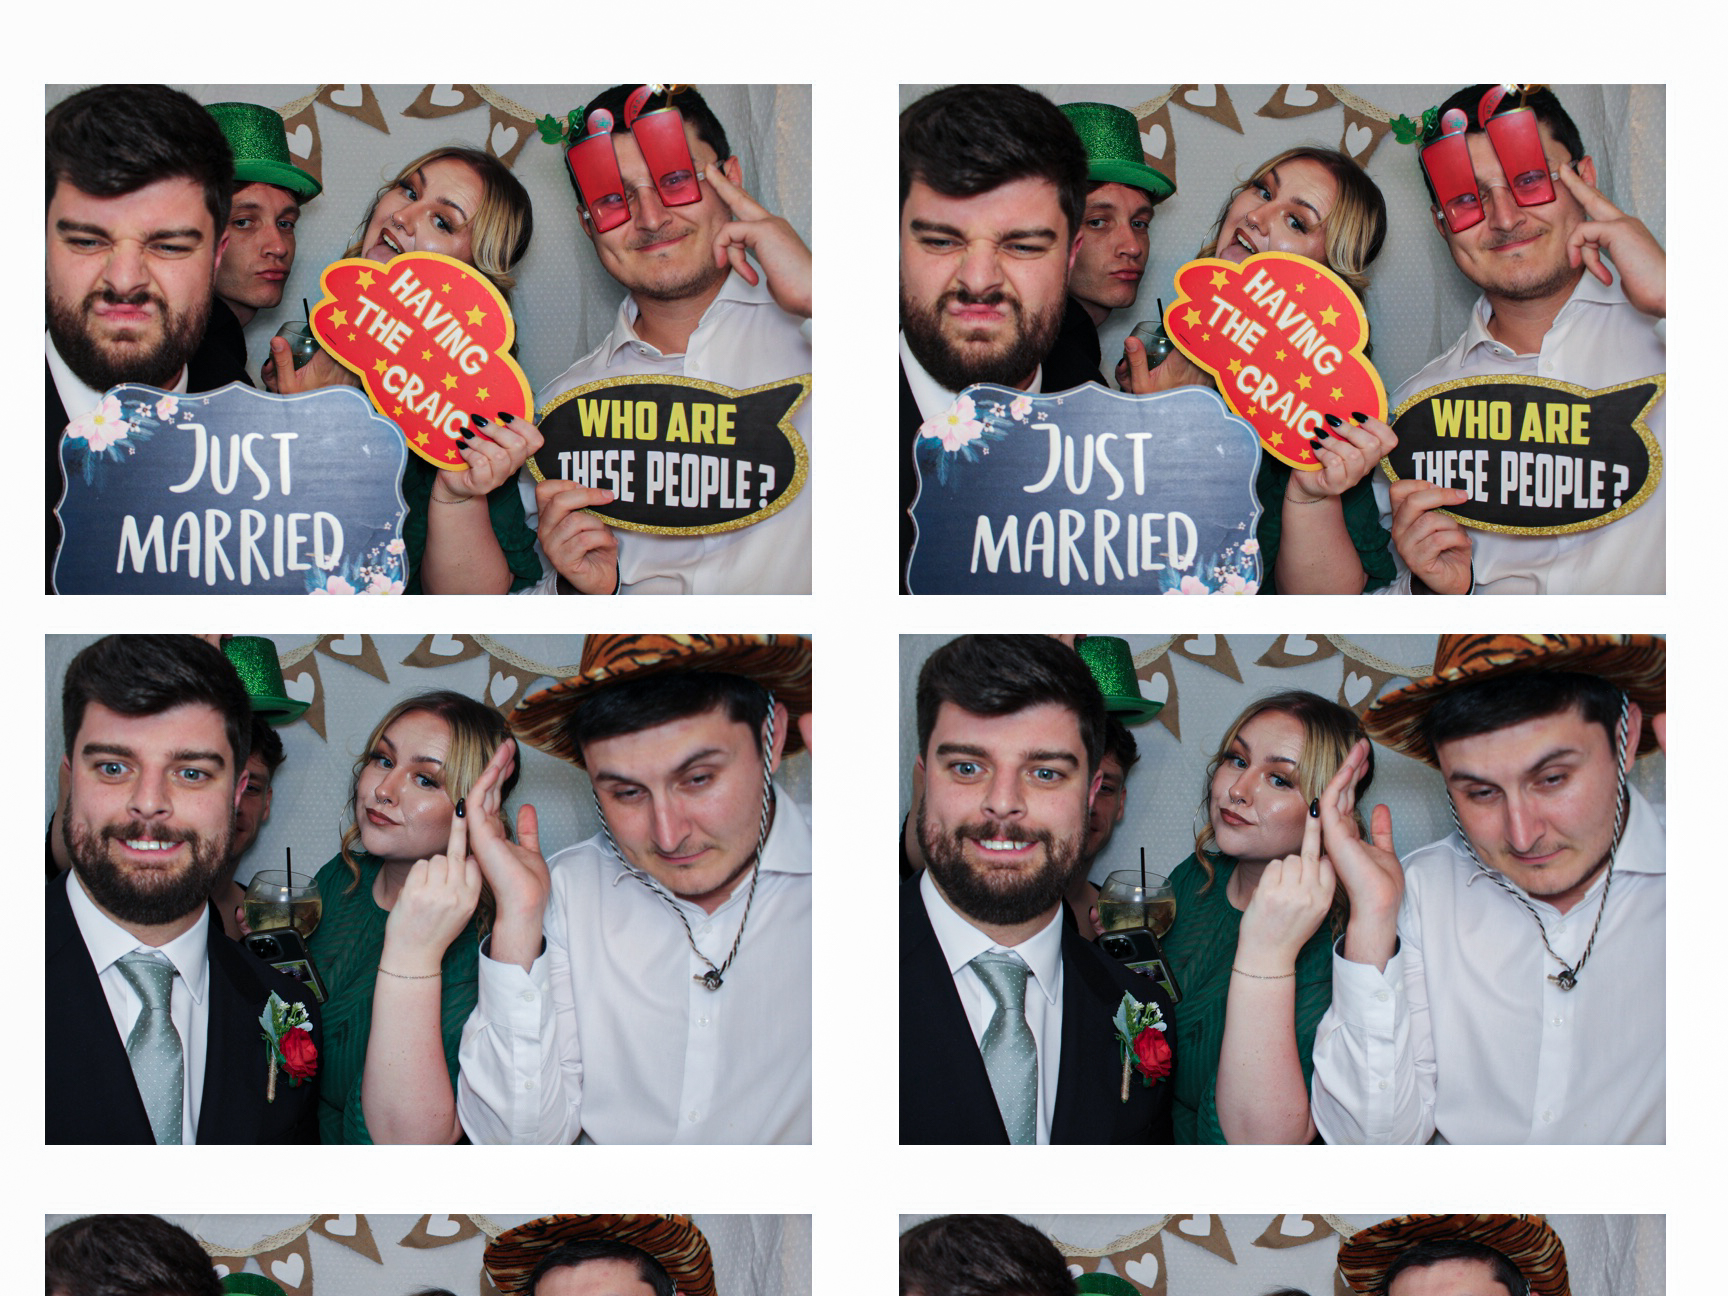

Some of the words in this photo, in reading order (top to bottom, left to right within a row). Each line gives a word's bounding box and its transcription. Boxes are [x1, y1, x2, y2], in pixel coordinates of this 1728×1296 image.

[353, 296, 414, 354] THE
[388, 267, 489, 375] HAVING
[1207, 296, 1268, 354] THE
[1242, 267, 1343, 375] HAVING
[382, 365, 469, 439] CRAIC
[577, 398, 658, 441] WHO
[665, 402, 738, 445] ARE
[1236, 365, 1323, 439] CRAIC
[1431, 398, 1512, 441] WHO
[1519, 402, 1592, 445] ARE
[169, 423, 299, 500] JUST
[558, 450, 636, 502] THESE
[1023, 423, 1153, 500] JUST
[1412, 450, 1490, 502] THESE
[116, 508, 344, 586] MARRIED
[970, 508, 1198, 586] MARRIED
